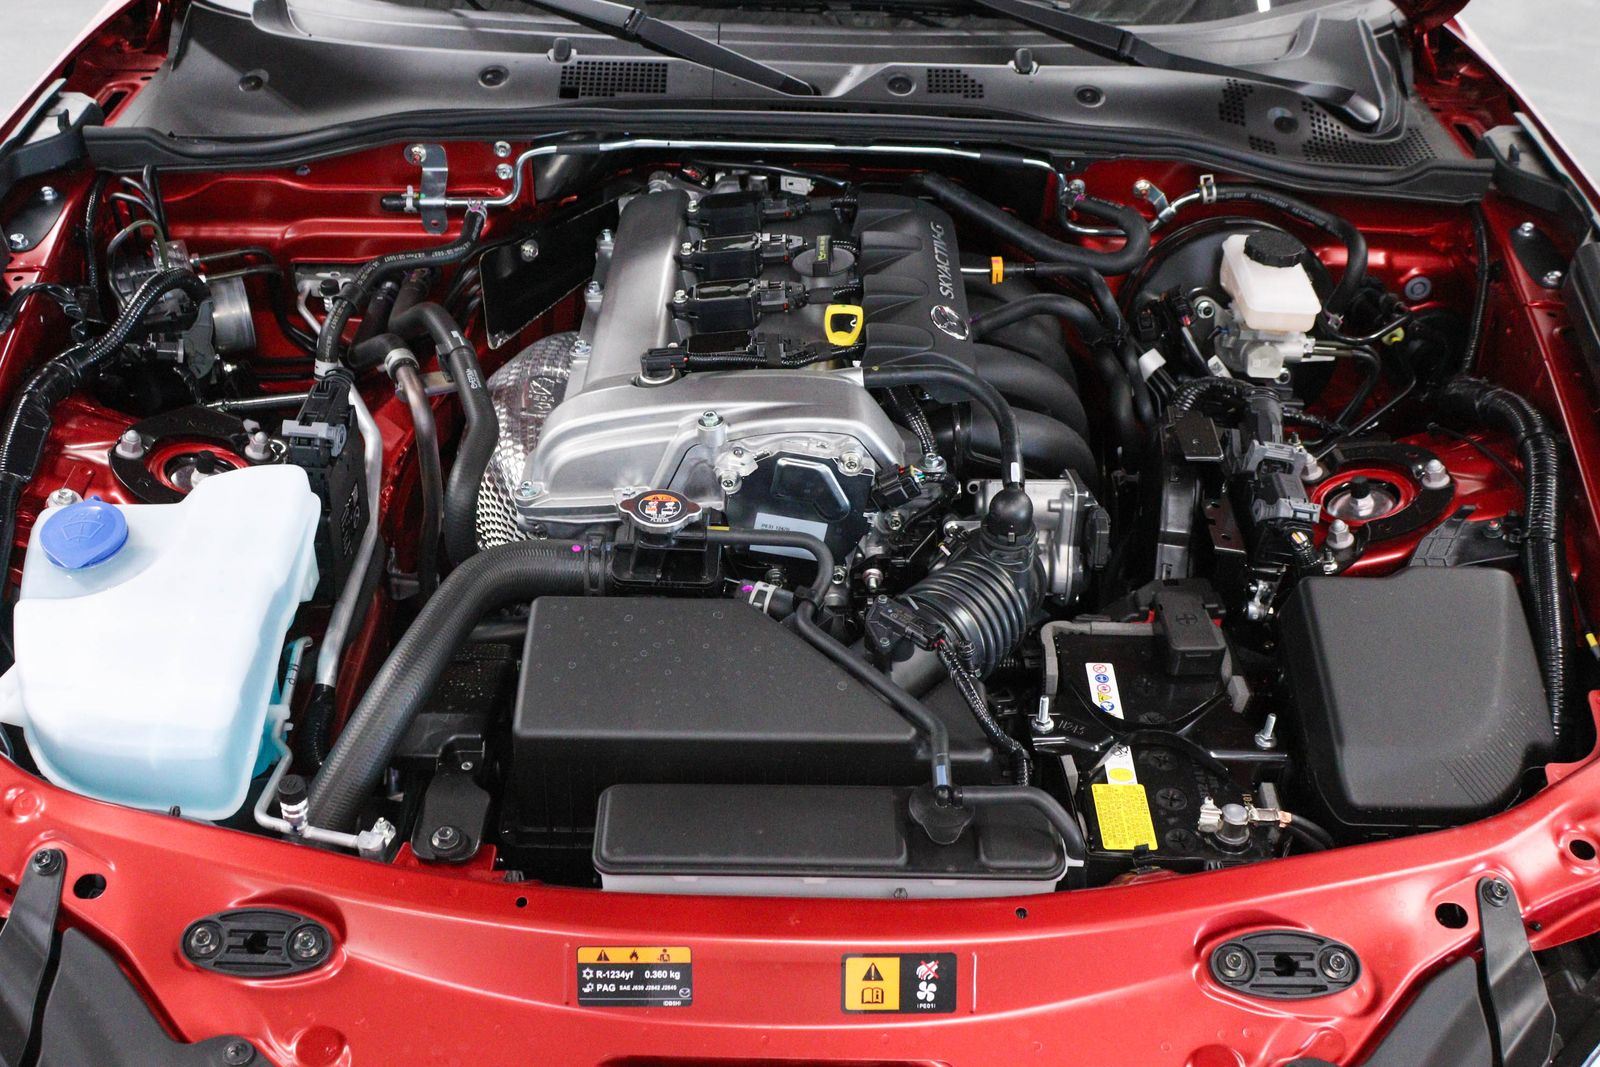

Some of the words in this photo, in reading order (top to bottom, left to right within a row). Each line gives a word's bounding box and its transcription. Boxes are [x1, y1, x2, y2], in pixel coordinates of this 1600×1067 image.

[930, 221, 955, 300] SKYACTIV-G
[596, 970, 634, 980] R-1234yf
[644, 970, 668, 979] 0.360
[669, 970, 681, 980] kg
[596, 983, 616, 992] PAG
